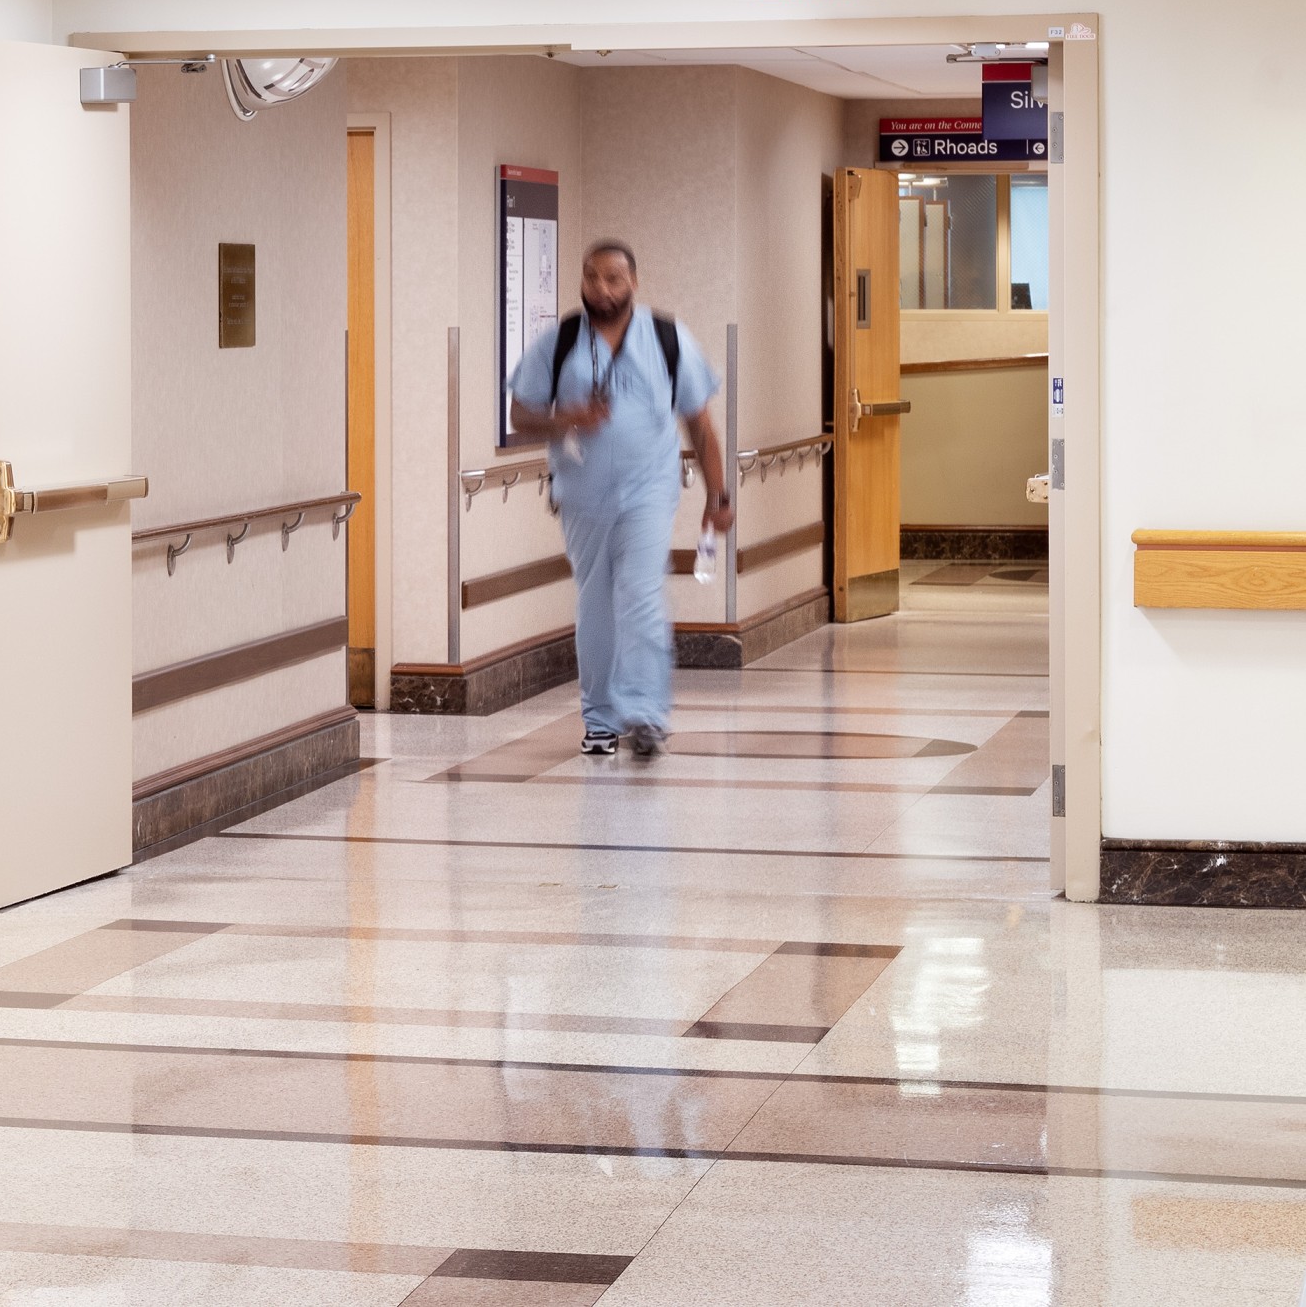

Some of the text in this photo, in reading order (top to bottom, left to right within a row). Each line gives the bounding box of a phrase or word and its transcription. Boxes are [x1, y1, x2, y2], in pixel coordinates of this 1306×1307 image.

[891, 121, 907, 131] You
[909, 121, 923, 130] are
[924, 122, 936, 130] on
[938, 120, 952, 130] the
[934, 139, 998, 155] Rhoads
